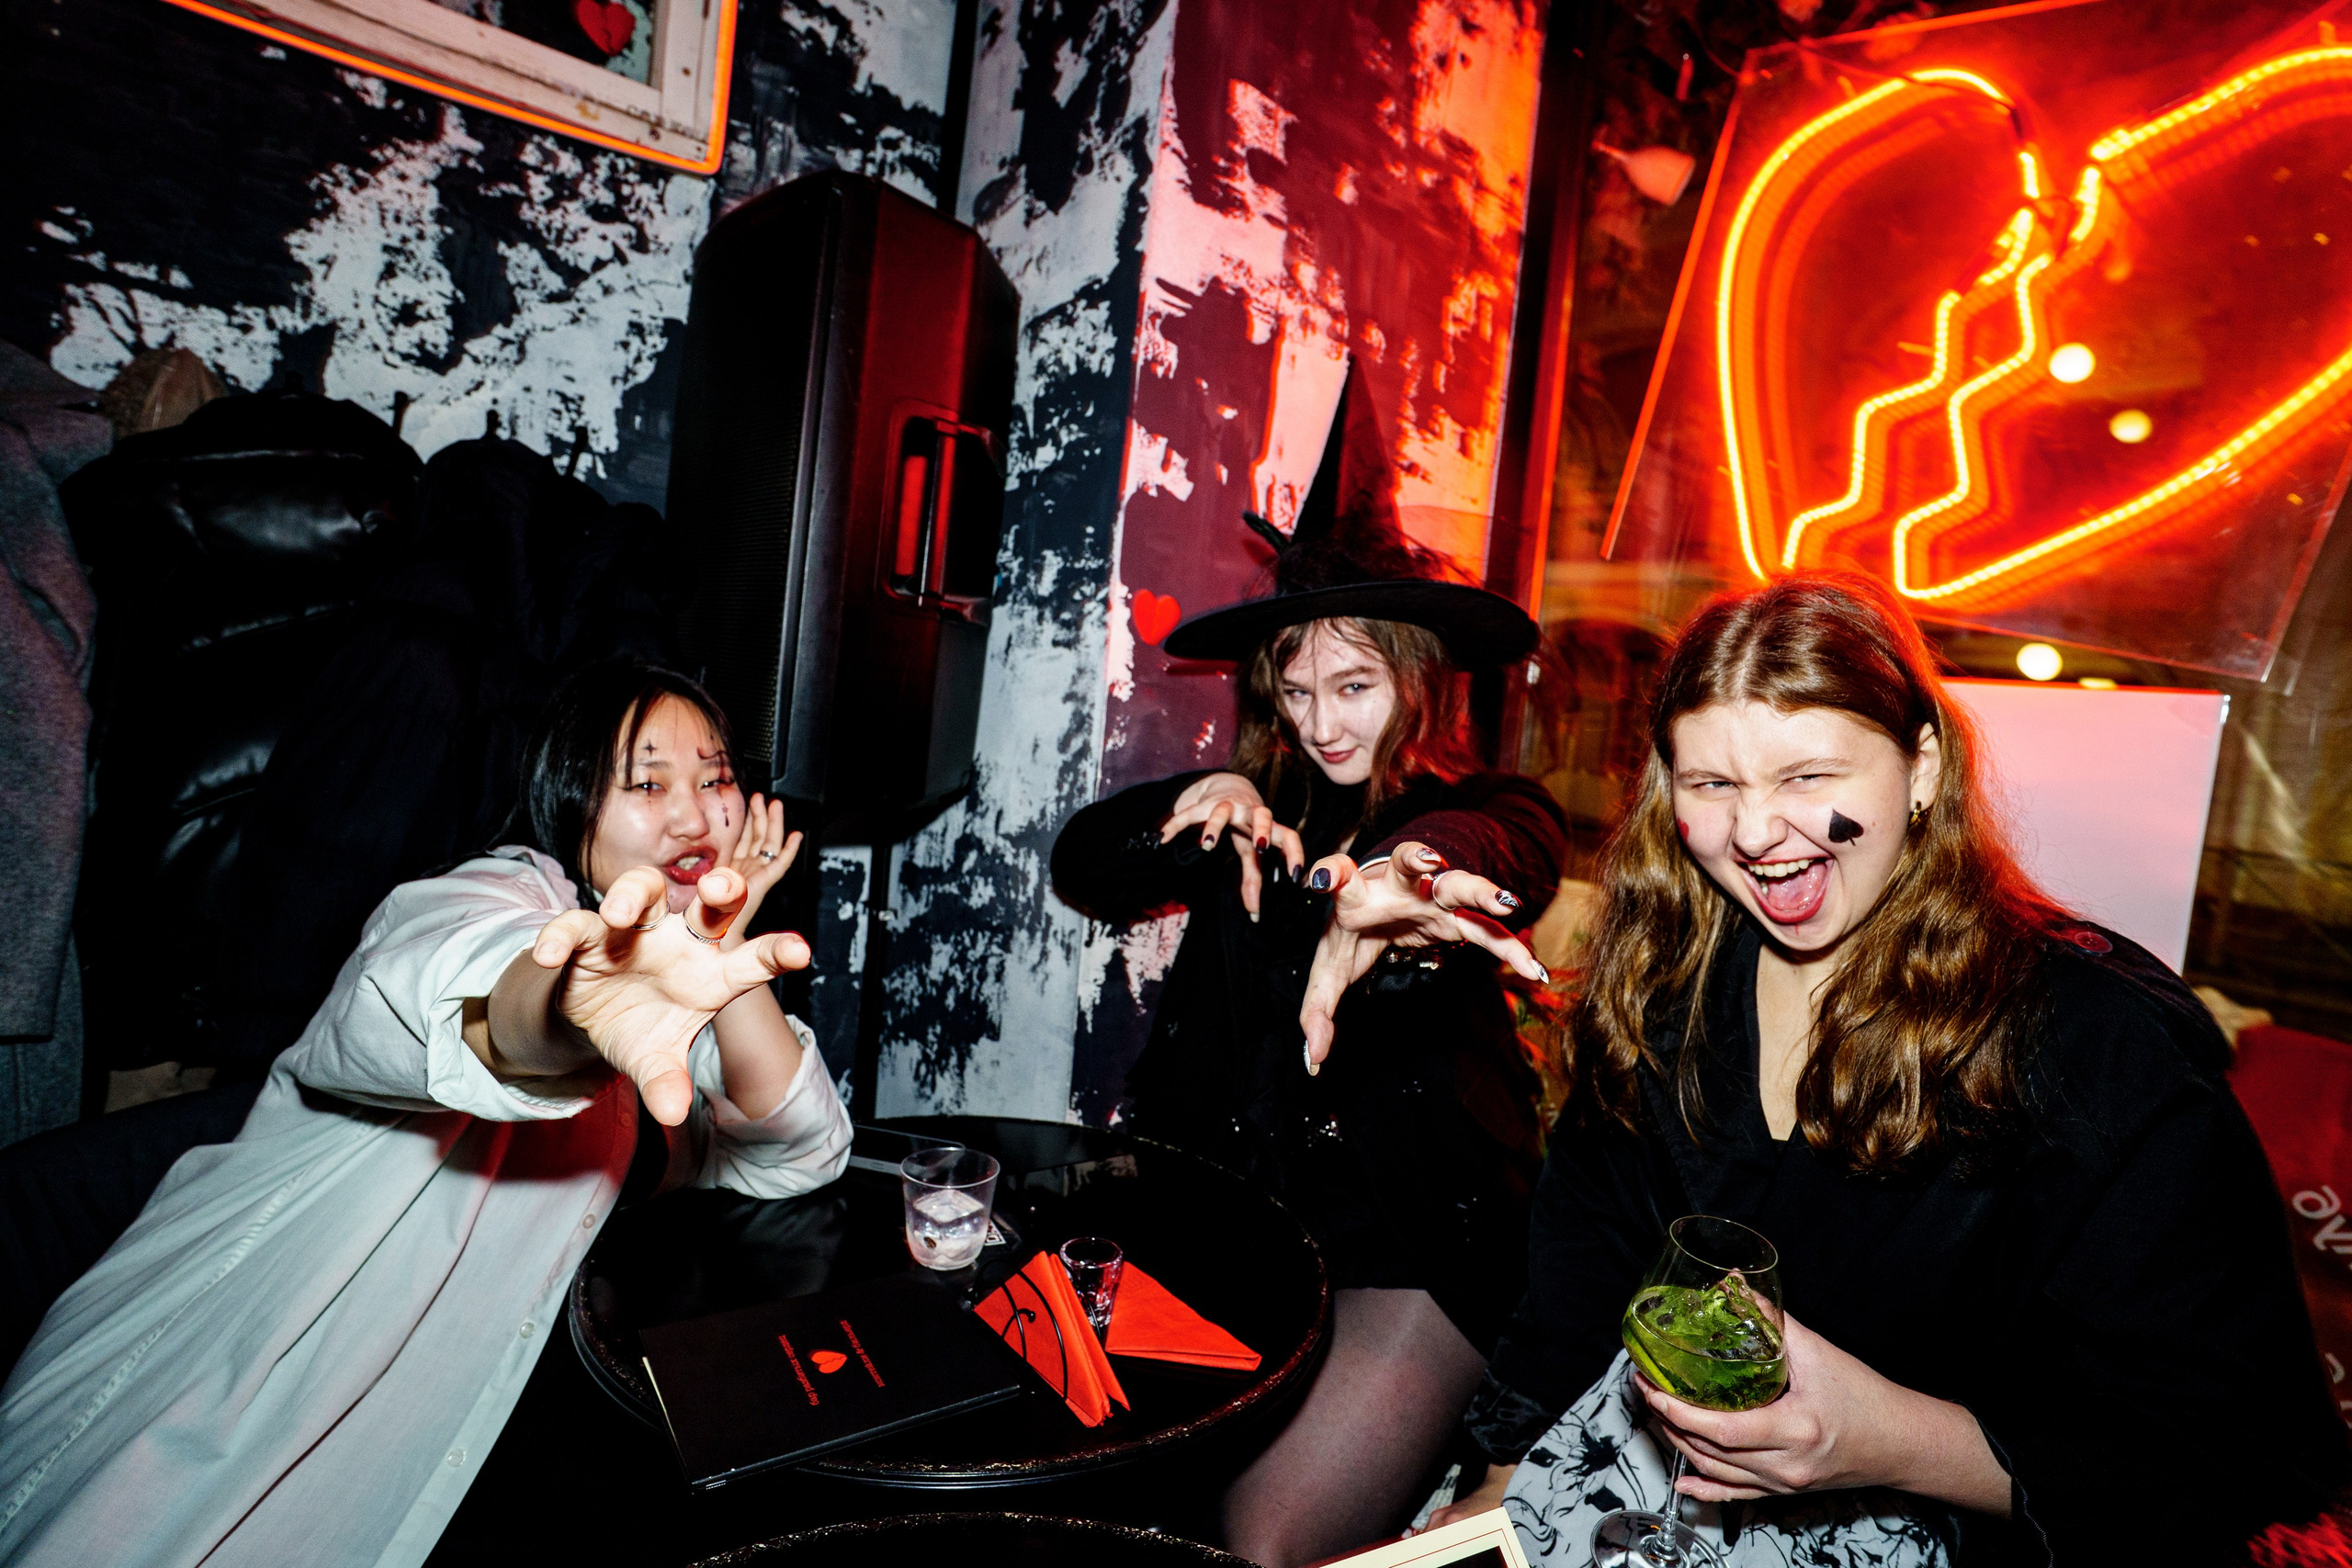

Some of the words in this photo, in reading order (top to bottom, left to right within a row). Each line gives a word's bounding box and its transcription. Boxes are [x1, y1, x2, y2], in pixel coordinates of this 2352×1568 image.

[778, 1335, 796, 1359] сердец
[840, 1319, 861, 1348] бильярд
[790, 1358, 815, 1393] разбитых
[860, 1354, 886, 1388] коктейли
[808, 1392, 820, 1406] бар
